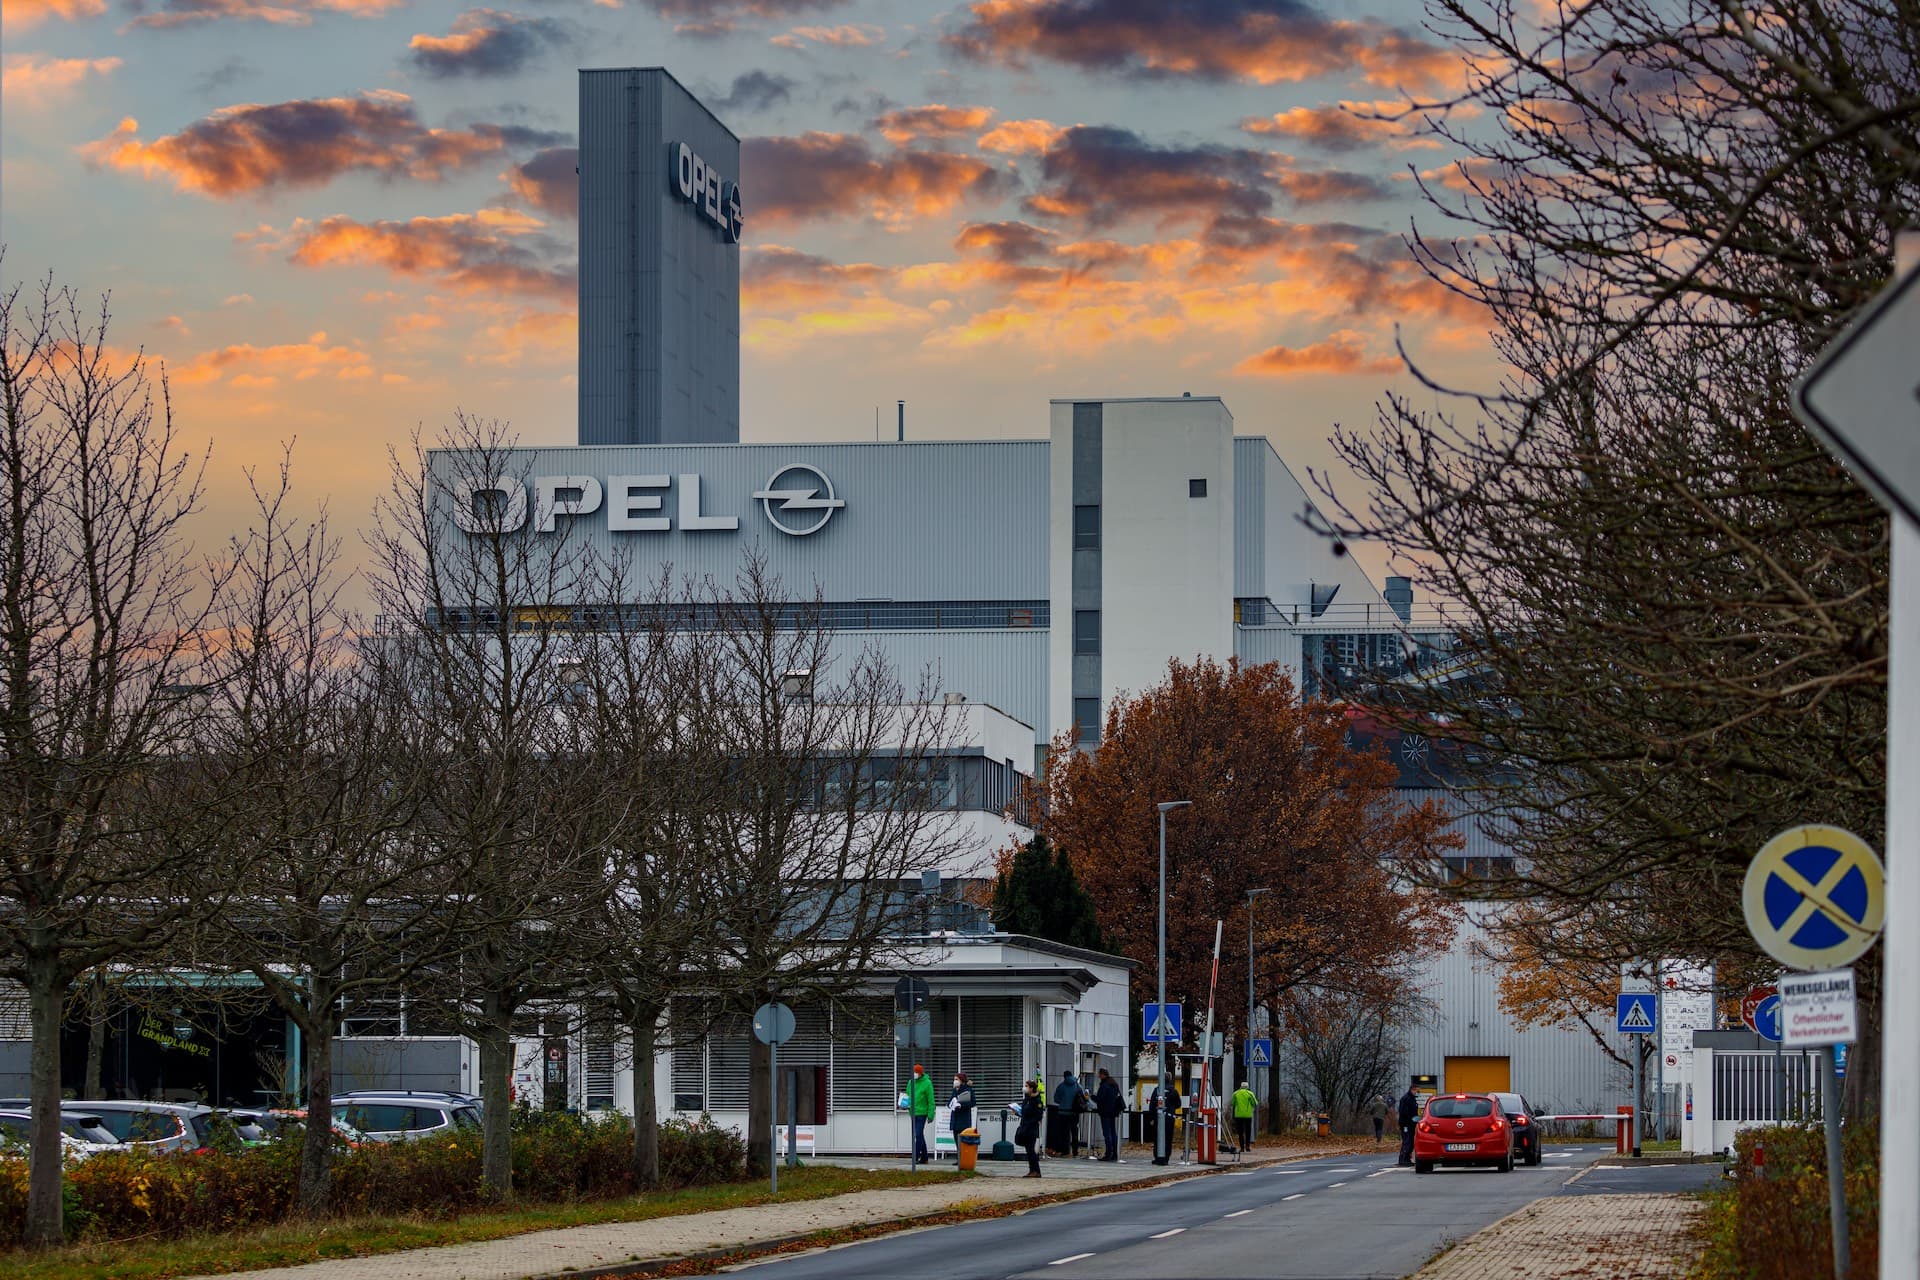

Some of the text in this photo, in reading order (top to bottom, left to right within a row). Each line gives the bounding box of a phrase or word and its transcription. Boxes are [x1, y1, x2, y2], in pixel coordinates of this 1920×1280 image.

[678, 142, 727, 229] OPEL
[452, 473, 738, 533] OPEL
[1784, 979, 1850, 995] WERKSGELÄNDE
[1782, 997, 1809, 1007] Adam
[1812, 994, 1834, 1005] Opel
[145, 1017, 162, 1029] DER
[1792, 1013, 1844, 1024] Öffentlicher
[1789, 1026, 1849, 1038] Verkehrsraum
[141, 1029, 198, 1053] GRANDLAND
